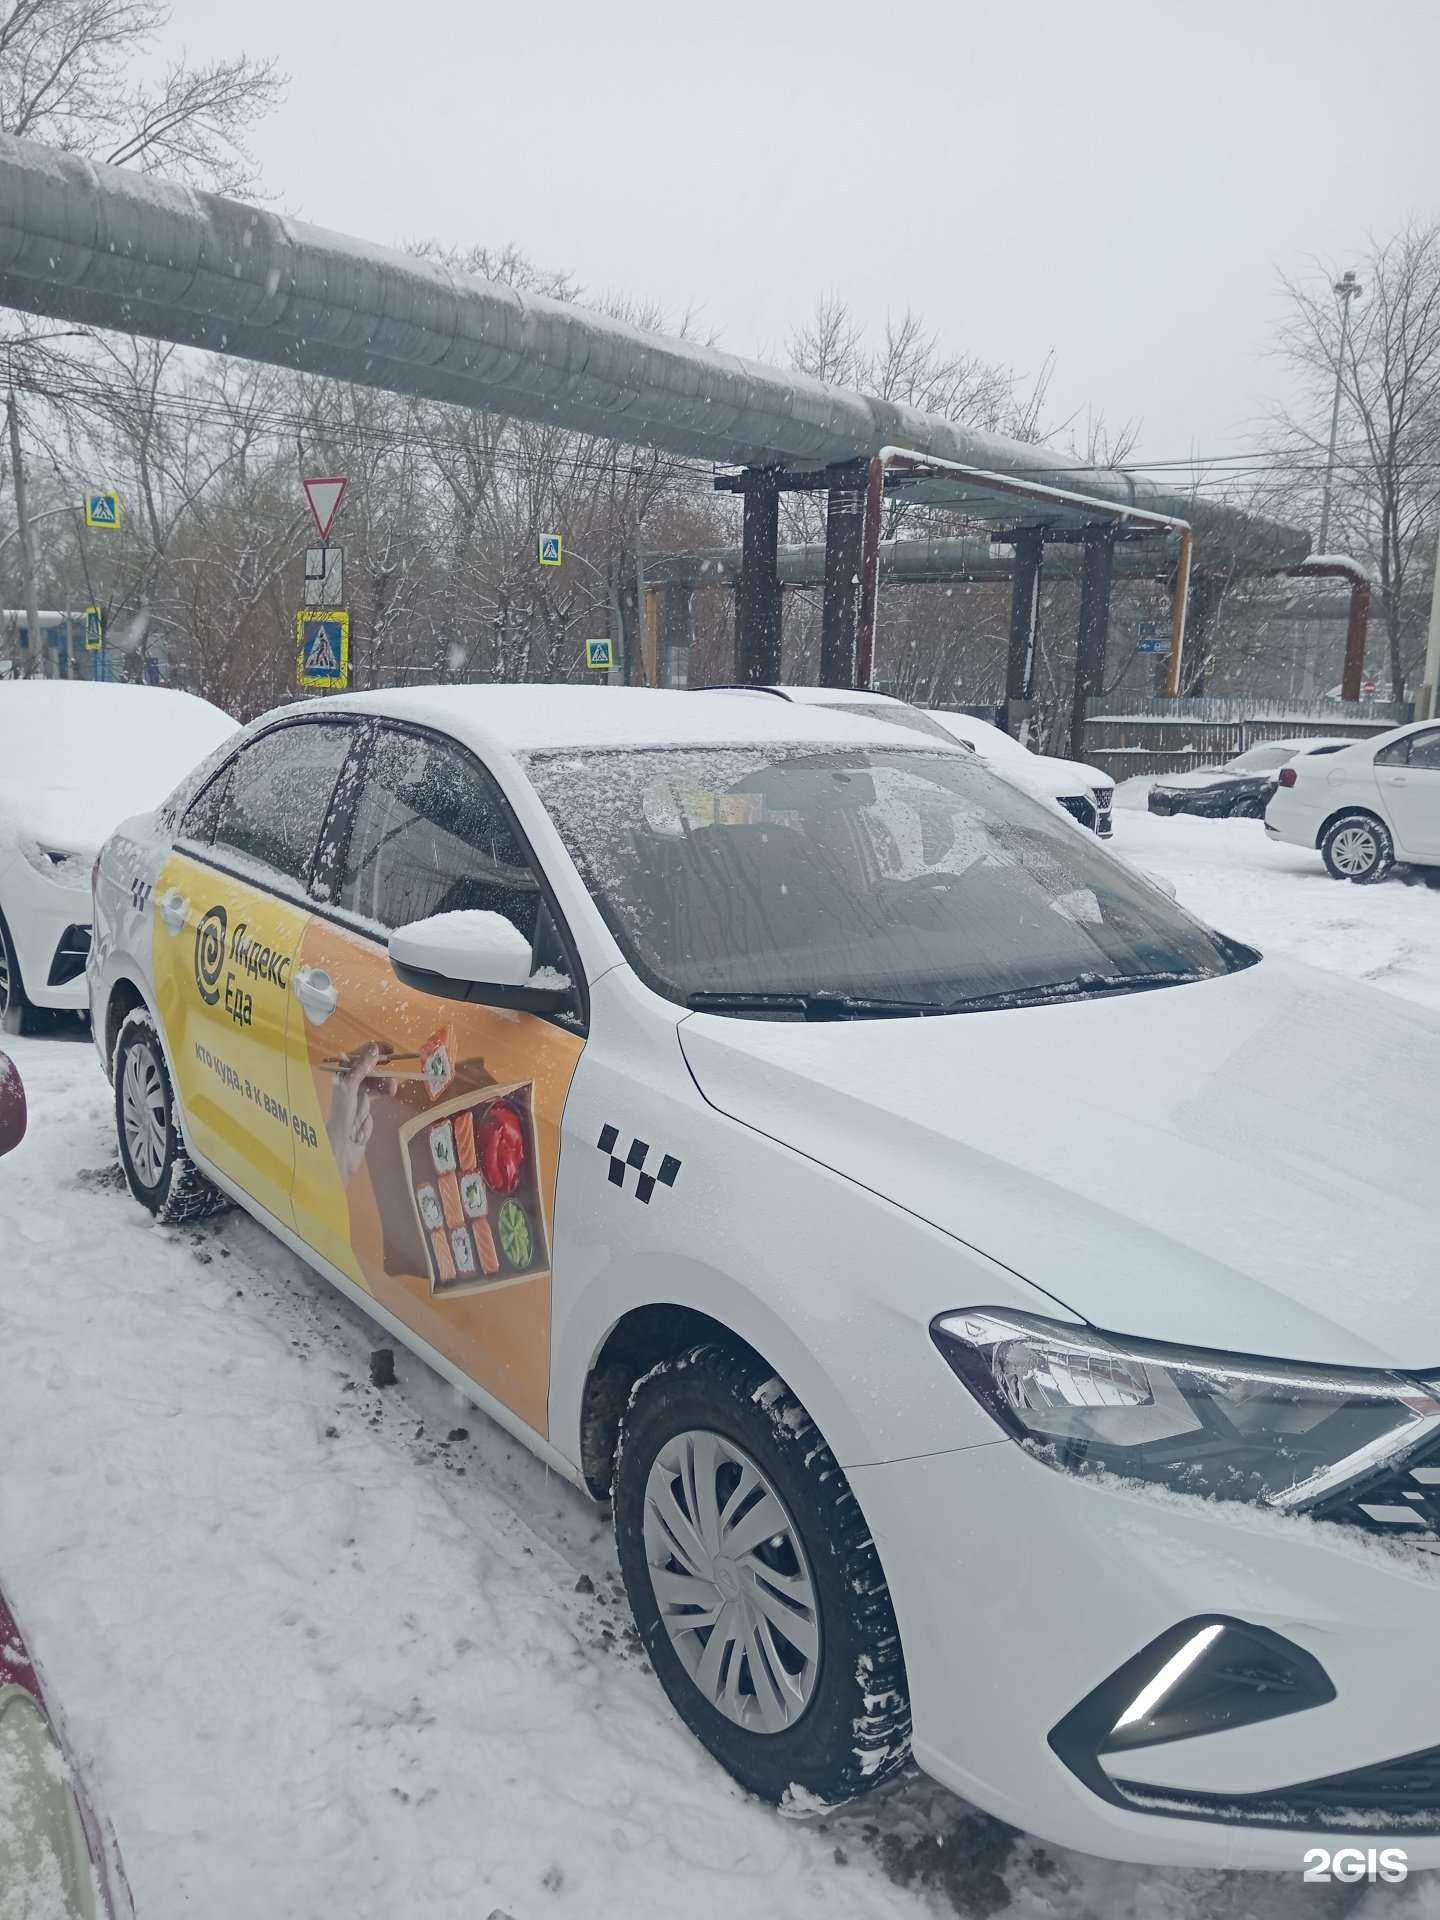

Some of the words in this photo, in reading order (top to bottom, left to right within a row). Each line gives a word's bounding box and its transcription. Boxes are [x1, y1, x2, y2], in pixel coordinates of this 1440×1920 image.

[229, 923, 291, 990] Яндекс
[225, 971, 252, 1027] Еда
[194, 1042, 213, 1069] кто
[213, 1056, 245, 1096] куда,
[244, 1079, 252, 1100] а
[253, 1085, 263, 1107] к
[264, 1093, 289, 1127] вам
[292, 1114, 319, 1148] еда
